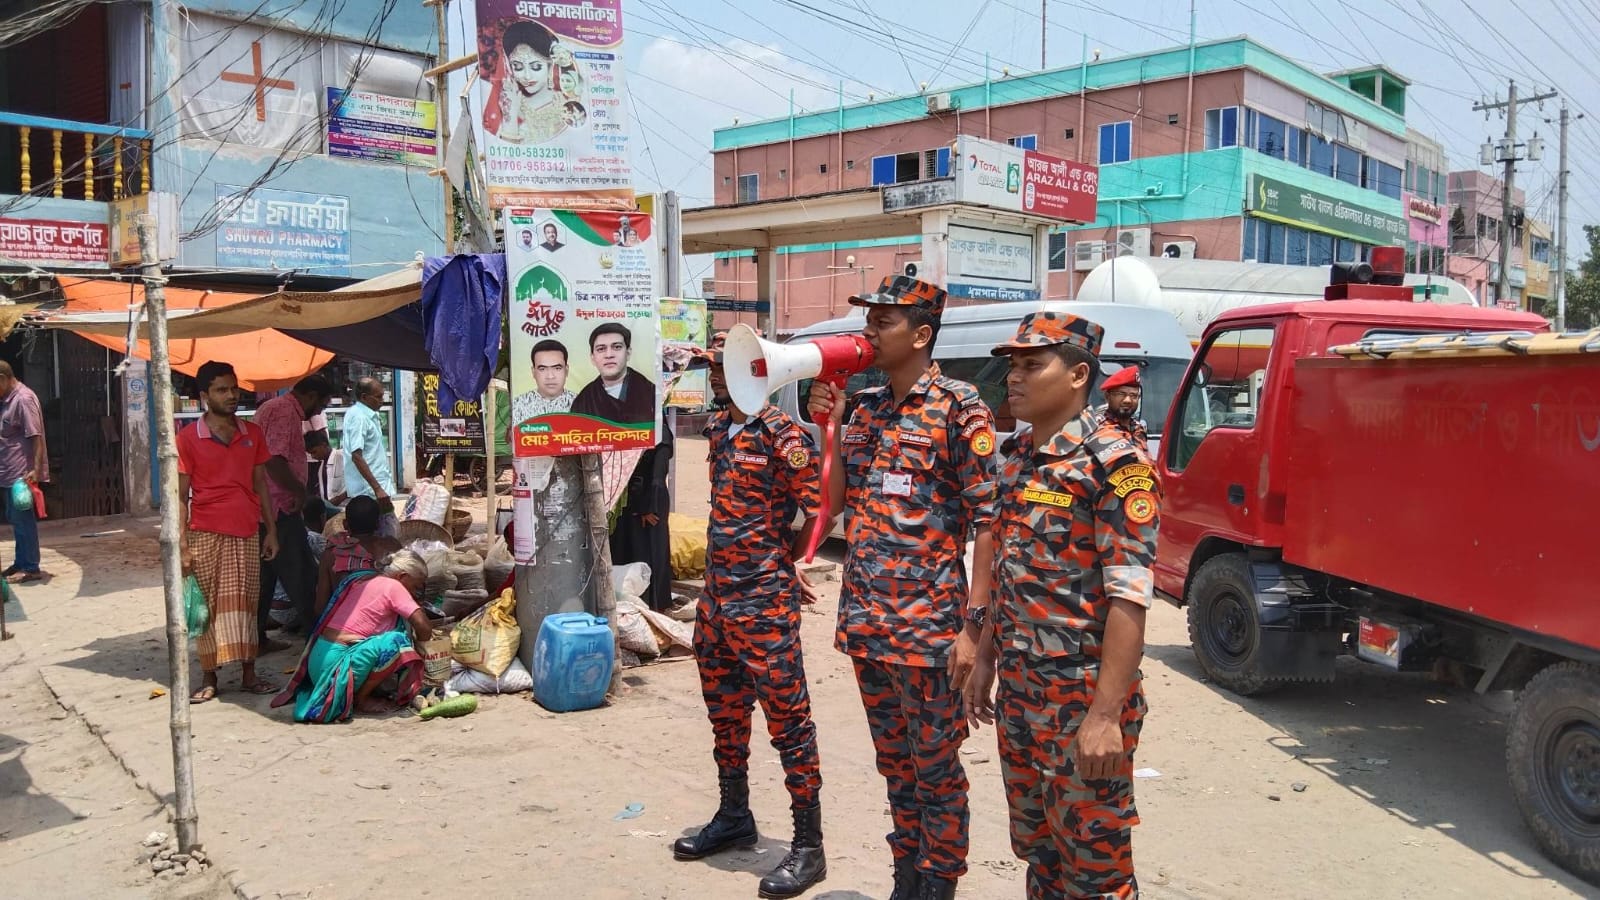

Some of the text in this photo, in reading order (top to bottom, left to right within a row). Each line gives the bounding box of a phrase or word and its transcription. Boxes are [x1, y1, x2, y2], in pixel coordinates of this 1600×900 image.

[489, 146, 564, 158] 01700-583230
[979, 160, 1002, 174] TOTAL
[1026, 171, 1097, 196] ARAZ ALI & CO.
[32, 225, 59, 246] বুক
[60, 224, 104, 247] কর্ণার
[278, 231, 343, 248] PHARMACY
[521, 428, 651, 447] মোঃ শাহিন শিকদার
[1117, 479, 1151, 495] RESCUE
